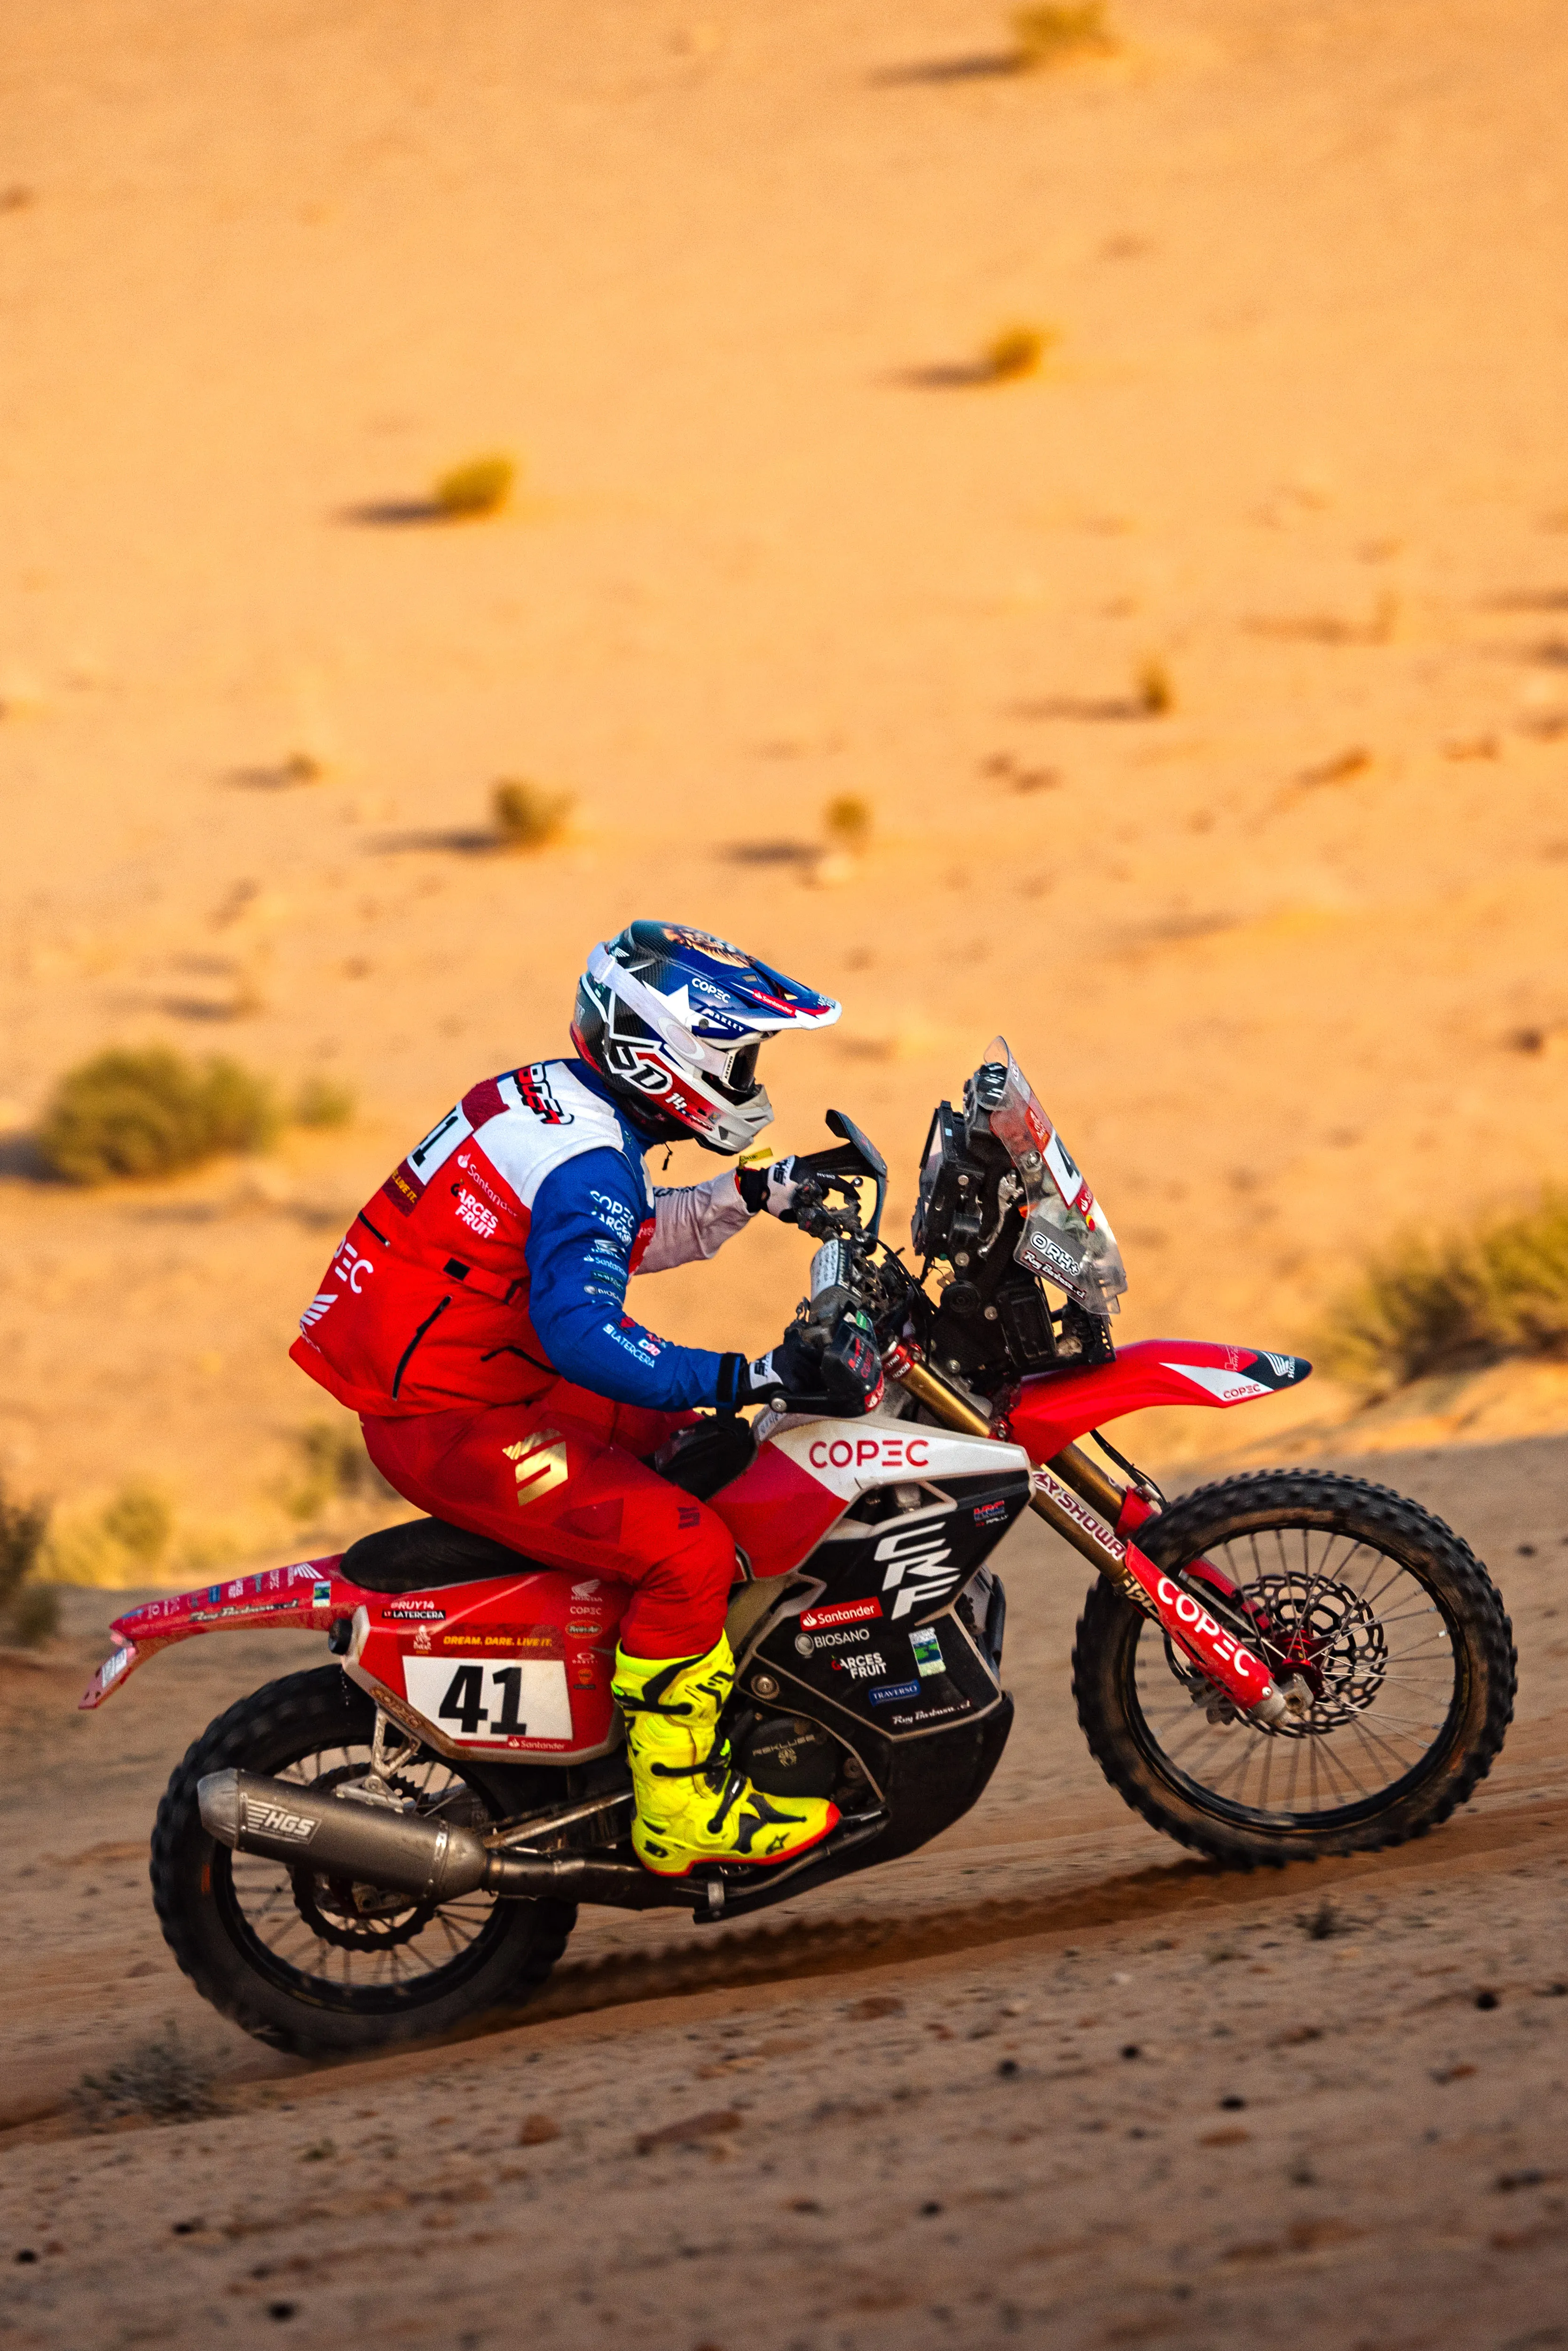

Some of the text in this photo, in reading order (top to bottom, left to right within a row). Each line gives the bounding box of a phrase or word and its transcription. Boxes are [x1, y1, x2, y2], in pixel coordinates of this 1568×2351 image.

[692, 978, 731, 1003] COPEC
[762, 994, 794, 1015] Santander
[665, 1092, 687, 1111] 14
[412, 1105, 459, 1167] 1
[455, 1205, 495, 1239] FRUIT
[1223, 1384, 1261, 1399] COPEC
[809, 1440, 929, 1468] COPEC
[1057, 1491, 1127, 1561] SHOWA
[393, 1610, 444, 1619] LATERCERA
[569, 1606, 602, 1615] COPEC
[817, 1605, 875, 1625] Santander
[1158, 1577, 1256, 1677] COPEC
[517, 1637, 540, 1646] LIVE
[814, 1628, 870, 1648] BIOSANO
[831, 1652, 883, 1671] GARCES
[850, 1662, 887, 1679] FRUIT
[439, 1665, 527, 1736] 41
[873, 1684, 917, 1700] TRAVERSO
[520, 1740, 565, 1750] Santander
[263, 1811, 316, 1837] HGS
